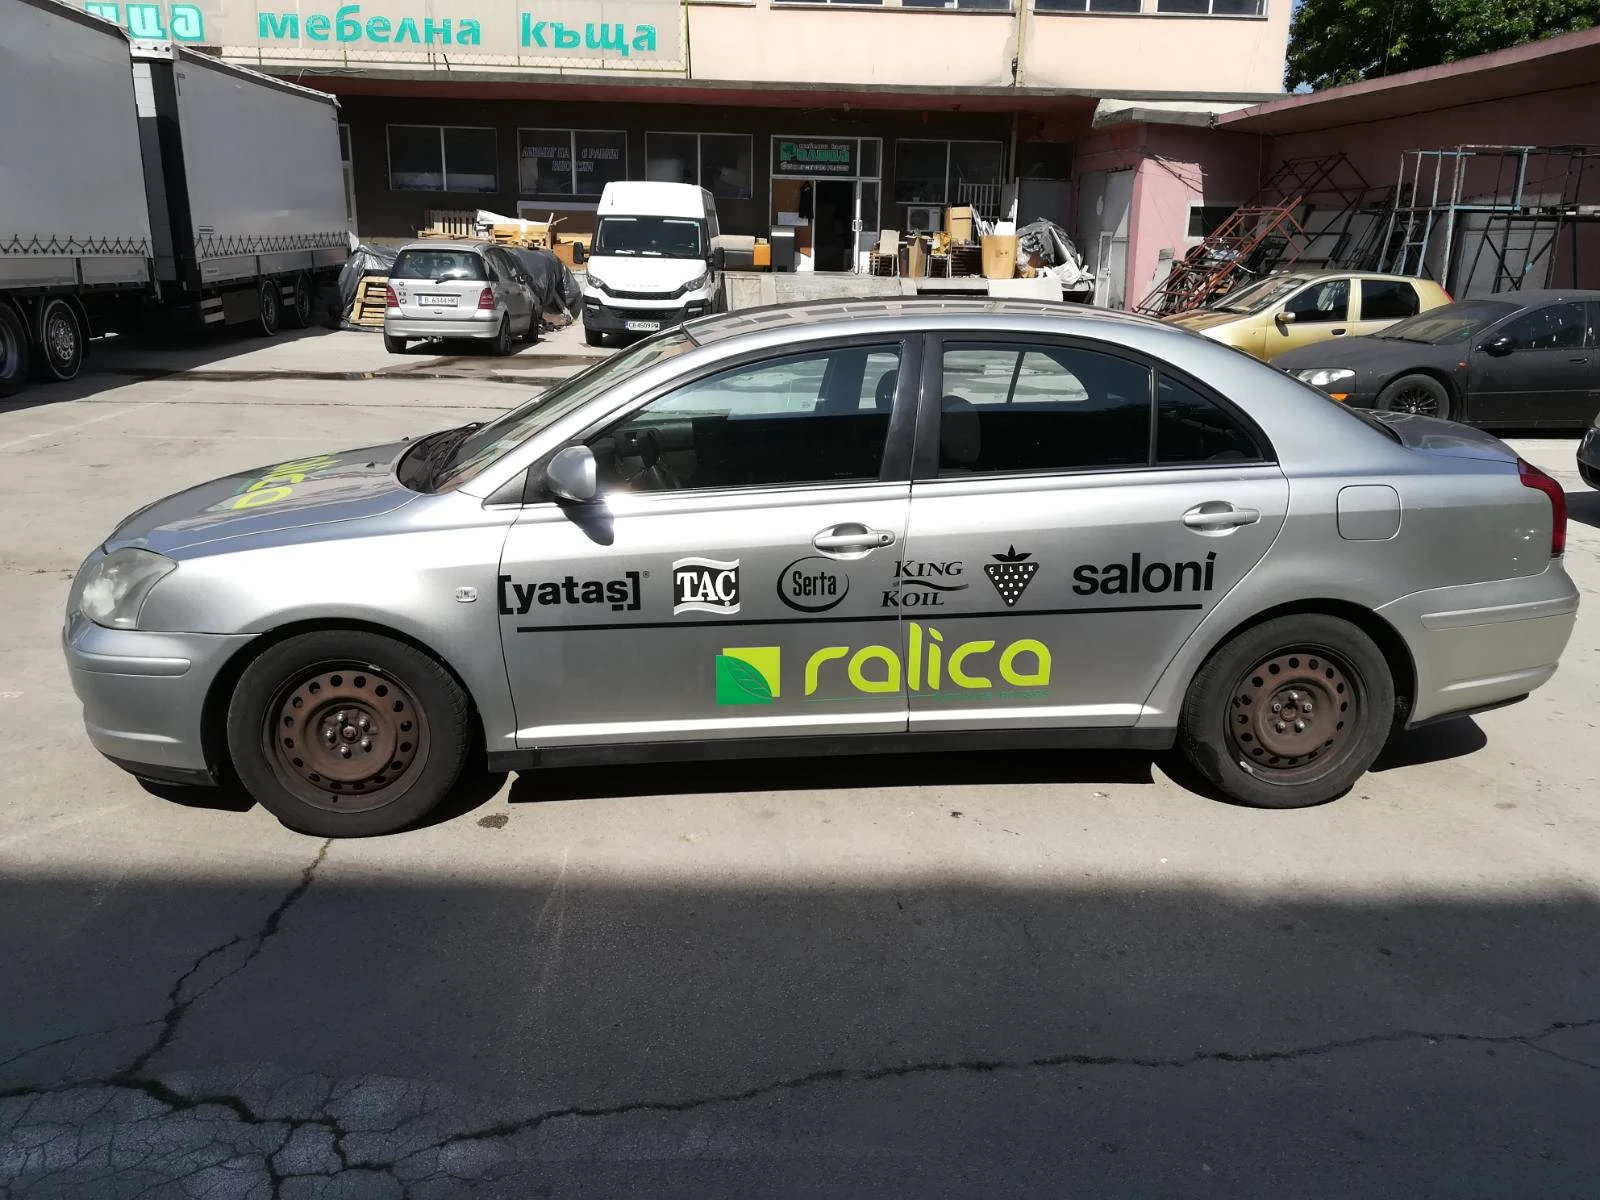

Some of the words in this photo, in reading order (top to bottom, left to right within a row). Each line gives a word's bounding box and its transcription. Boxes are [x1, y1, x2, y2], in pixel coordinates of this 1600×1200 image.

[258, 4, 482, 46] мебелна
[520, 11, 657, 57] къща
[792, 570, 837, 597] Serta
[893, 560, 964, 578] KING
[1072, 551, 1217, 596] saloni
[879, 590, 945, 608] KOIL
[804, 622, 1052, 697] ralica
